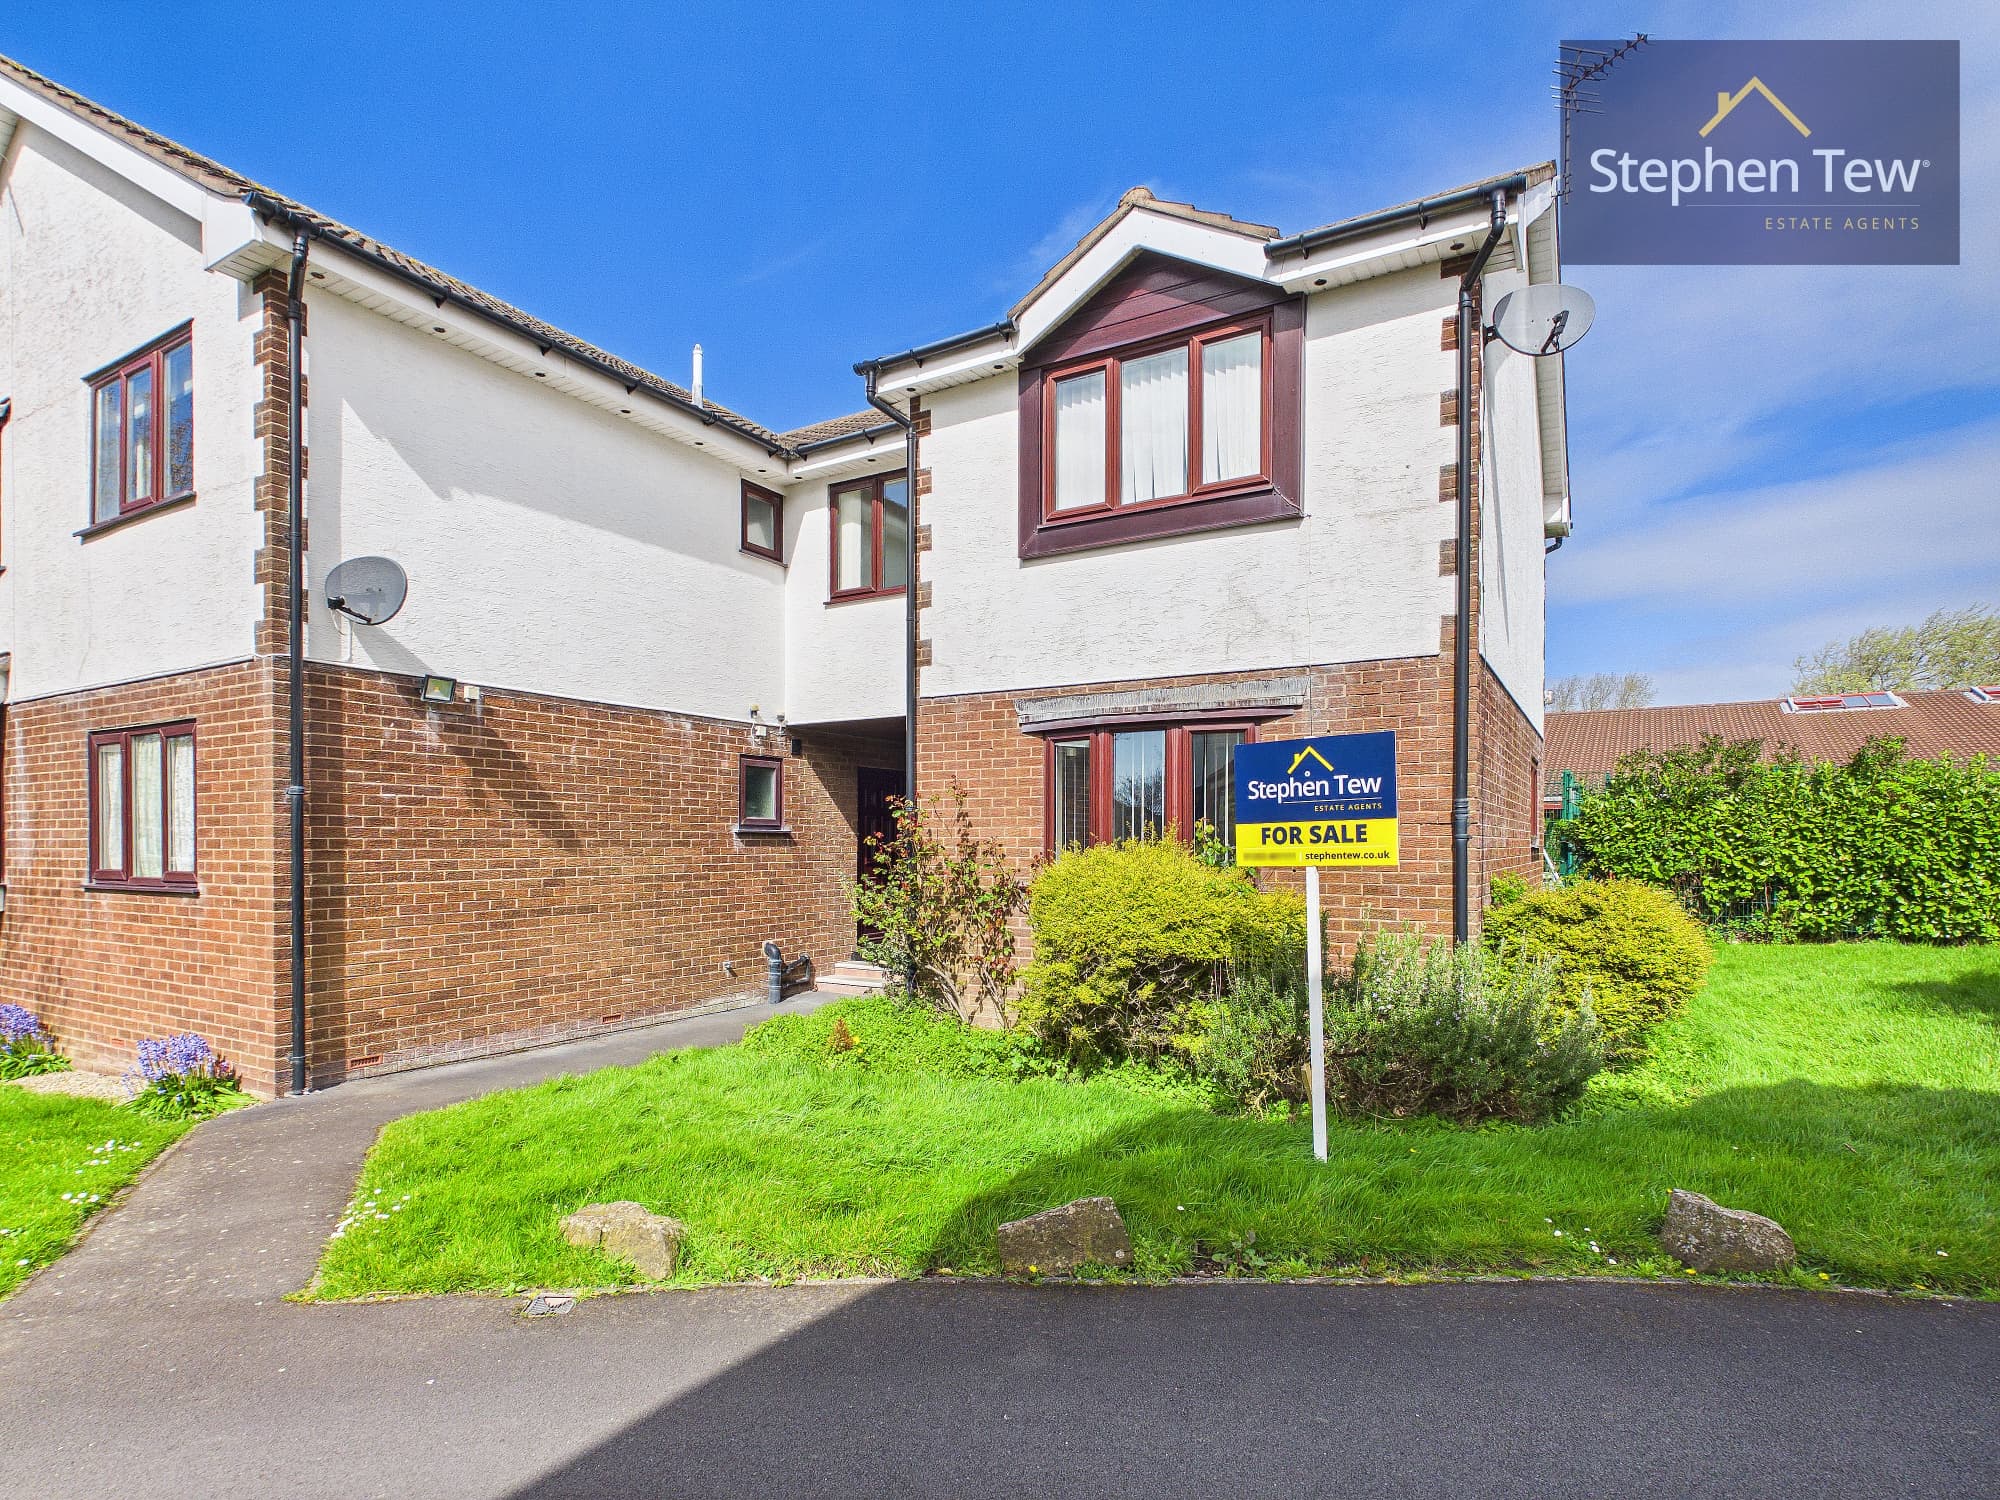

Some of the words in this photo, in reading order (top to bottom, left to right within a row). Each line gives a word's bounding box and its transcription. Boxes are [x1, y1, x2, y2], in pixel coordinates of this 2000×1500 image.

[1248, 776, 1329, 804] Stephen
[1333, 774, 1382, 795] Tew
[1314, 804, 1345, 812] ESTATE
[1347, 802, 1383, 811] AGENTS
[1261, 826, 1304, 846] FOR
[1309, 824, 1368, 844] SALE
[1305, 850, 1390, 862] stephentew.co.uk
